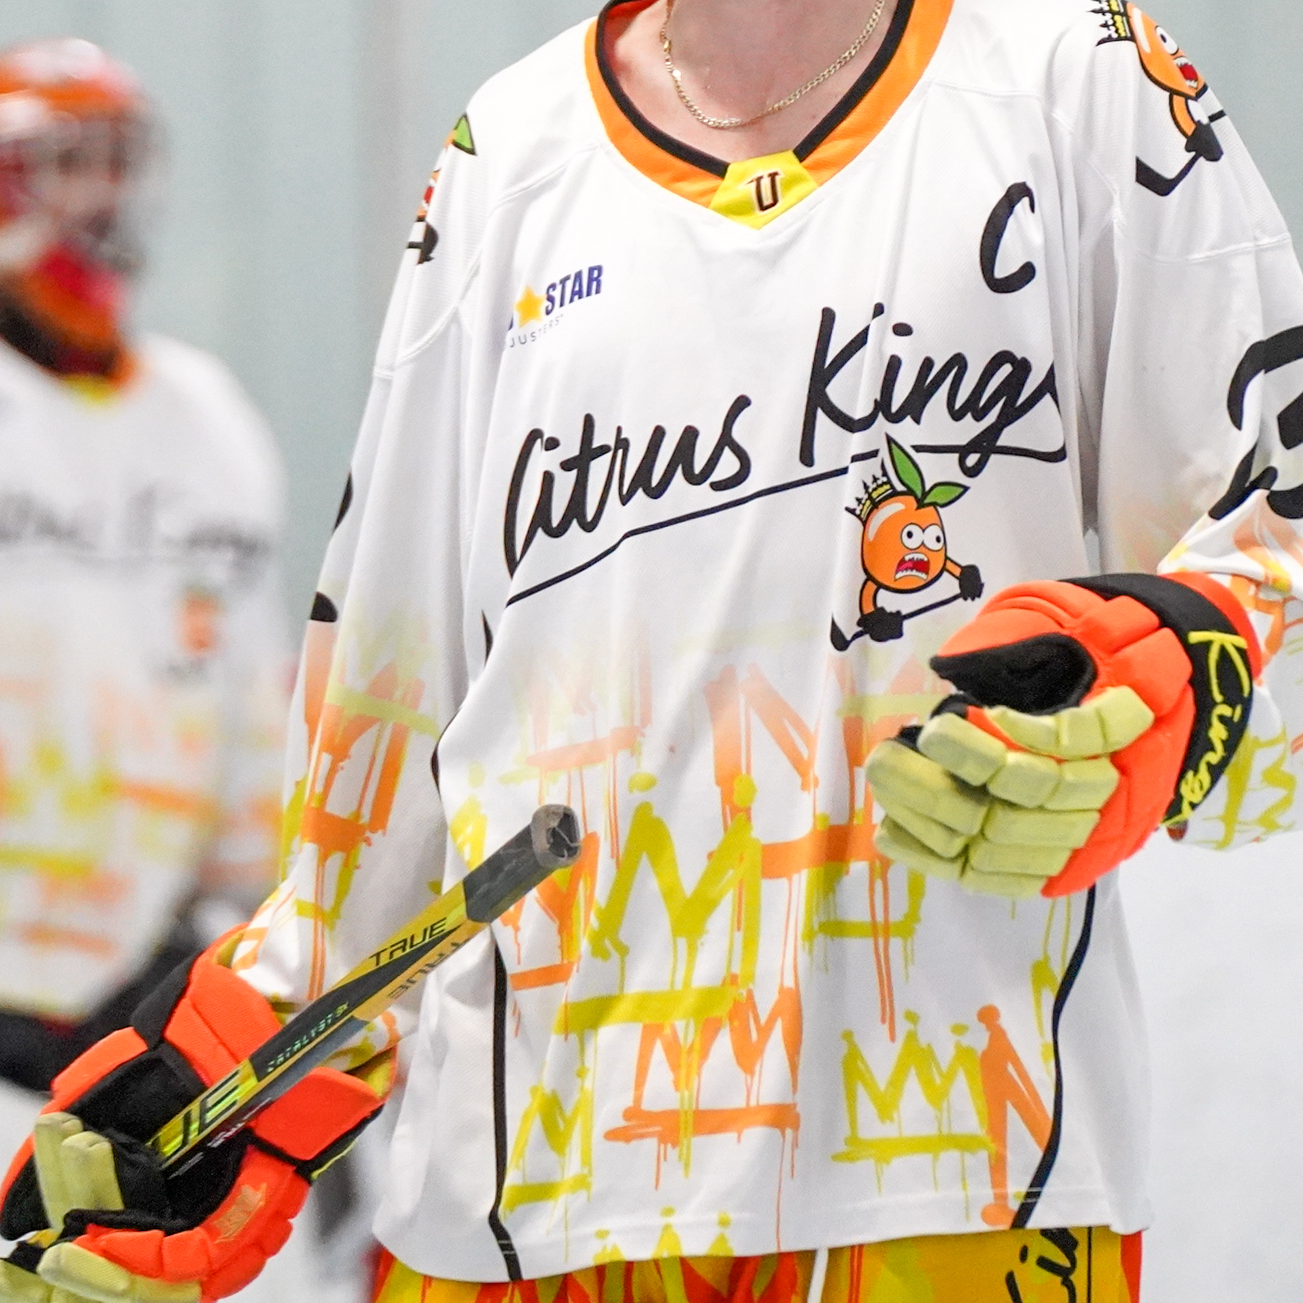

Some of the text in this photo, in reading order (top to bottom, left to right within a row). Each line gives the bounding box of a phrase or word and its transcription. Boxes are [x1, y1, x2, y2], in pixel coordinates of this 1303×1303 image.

[980, 181, 1036, 294] C
[545, 264, 603, 316] STAR
[503, 394, 752, 579] Citrus
[368, 917, 447, 967] TRUE
